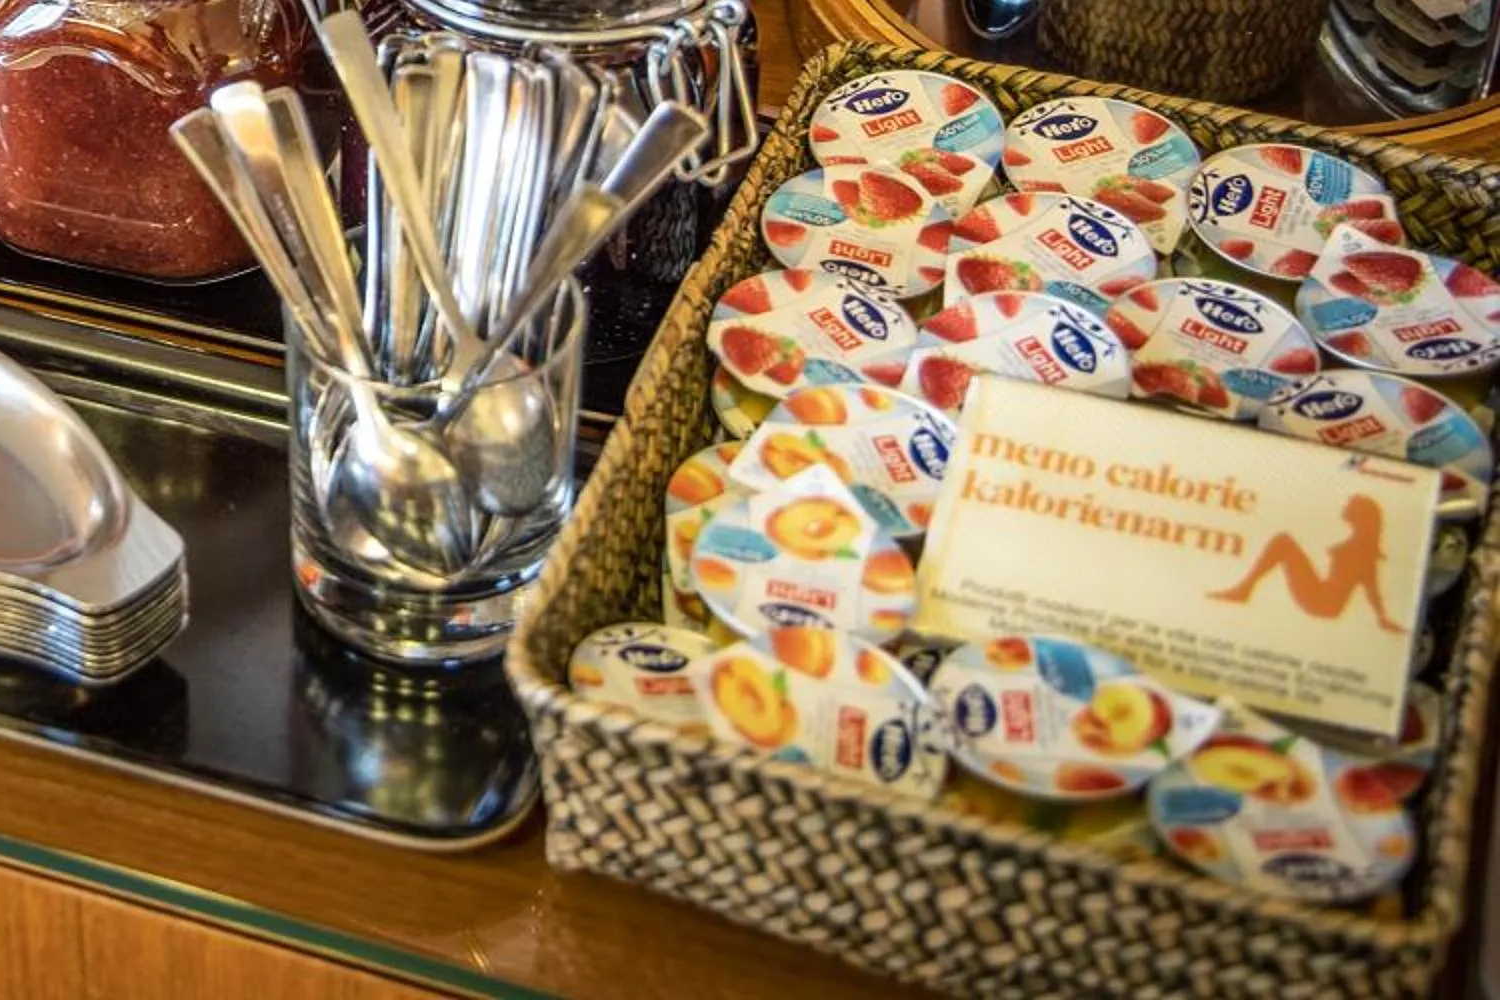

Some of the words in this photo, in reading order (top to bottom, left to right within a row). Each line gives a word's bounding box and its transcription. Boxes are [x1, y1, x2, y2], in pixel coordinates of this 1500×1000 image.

[853, 91, 905, 113] Hero
[865, 109, 919, 136] Light
[1041, 116, 1093, 138] Hero
[1055, 137, 1111, 163] Light
[1217, 175, 1248, 215] Hero
[1254, 187, 1286, 229] Light
[831, 240, 890, 267] Light
[1042, 229, 1093, 271] Light
[1071, 218, 1116, 255] Hero
[823, 260, 880, 286] Hero
[813, 307, 862, 351] Light
[844, 299, 886, 338] Hero
[1202, 301, 1259, 332] Hero
[1395, 317, 1461, 342] Light
[1054, 328, 1094, 370] Hero
[1183, 319, 1247, 354] Light
[1412, 342, 1472, 360] Hero
[1018, 336, 1067, 384] Light
[1302, 393, 1359, 418] Hero
[1322, 415, 1385, 446] Light
[873, 436, 916, 483] Light
[913, 433, 946, 478] Hero
[970, 431, 1096, 480] meno
[1105, 462, 1258, 513] calorie
[960, 468, 1246, 557] kalorienarm
